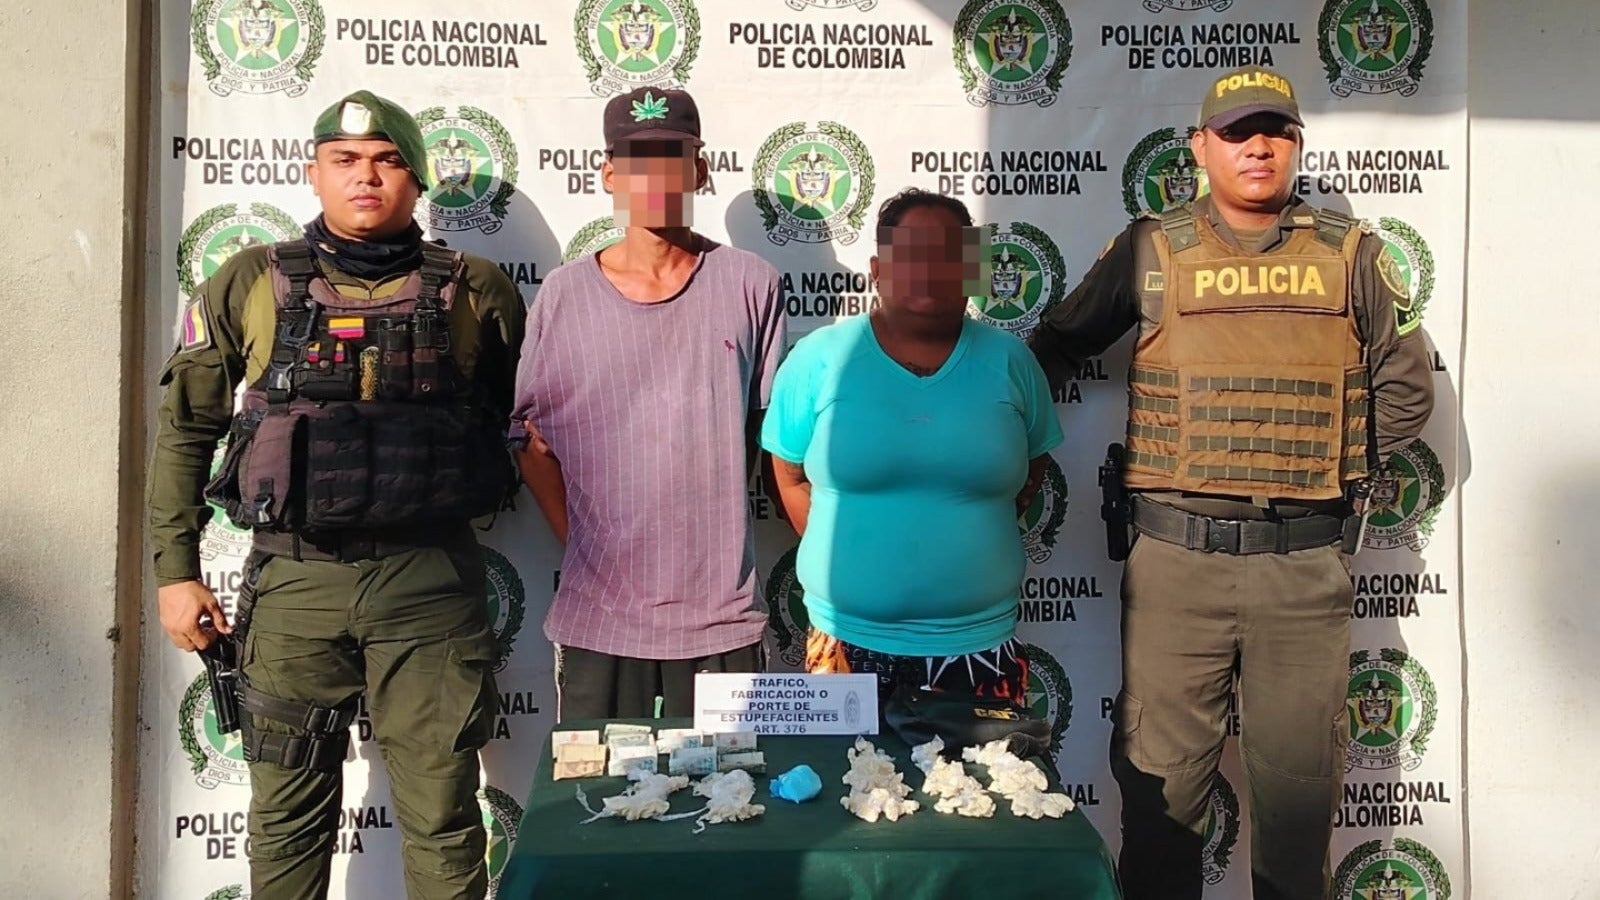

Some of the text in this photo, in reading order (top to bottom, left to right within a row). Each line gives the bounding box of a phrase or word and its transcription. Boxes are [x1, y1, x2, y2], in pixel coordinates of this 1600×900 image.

[967, 0, 999, 40] REPUBLICA
[1026, 0, 1057, 40] COLOMBIA
[336, 18, 548, 46] POLICIA NACIONAL
[729, 22, 933, 46] POLICIA NACIONAL
[1101, 22, 1300, 47] POLICIA NACIONAL
[217, 52, 303, 79] POLICIA NACIONAL
[365, 43, 519, 69] DE COLOMBIA
[598, 54, 679, 81] POLICIA NACIONAL
[758, 46, 906, 70] DE COLOMBIA
[1128, 46, 1274, 70] DE COLOMBIA
[1336, 54, 1414, 80] POLICIA NACIONAL
[221, 76, 297, 91] DIOS Y PATRIA
[601, 78, 623, 91] DIOS
[974, 63, 1053, 90] POLICIA NACIONAL
[1341, 78, 1409, 92] DIOS Y PATRIA
[978, 88, 1047, 103] DIOS Y PATRIA
[173, 136, 265, 160] POLICIA
[446, 119, 502, 164] DE COLOMBIA
[539, 148, 603, 171] POLIC
[767, 139, 799, 178] REPUBLICA
[806, 134, 819, 142] DE
[827, 138, 859, 177] COLOMBIA
[911, 150, 1107, 173] POLICIA NACIONAL
[1136, 139, 1188, 184] REPUBLICA DE
[1347, 149, 1450, 171] NACIONAL
[203, 162, 310, 185] DE COLO
[568, 173, 596, 195] DE
[938, 174, 1081, 196] DE COLOMBIA
[1318, 172, 1423, 195] COLOMBIA
[456, 189, 497, 217] NACIONAL
[445, 221, 451, 229] Y
[458, 214, 492, 229] PATRIA
[774, 201, 854, 229] POLICIA NACIONAL
[193, 220, 230, 263] REPUBLICA
[237, 215, 252, 224] DE
[778, 226, 849, 241] DIOS Y PATRIA
[998, 233, 1051, 277] DE COLOMBIA
[1387, 234, 1419, 272] COLOMBIA
[1195, 265, 1326, 298] POLICIA
[786, 295, 882, 317] OLOMBIA
[1007, 302, 1046, 329] NACIONAL
[207, 521, 236, 541] OLICIA
[1386, 508, 1424, 535] NACIONAL
[206, 540, 242, 555] DIOS Y
[1377, 539, 1383, 547] Y
[1388, 532, 1418, 546] PATRIA
[1020, 577, 1103, 599] CIONAL
[1351, 596, 1420, 619] OMBIA
[1368, 661, 1381, 669] DE
[751, 678, 809, 689] TRAFICO,
[1030, 662, 1056, 699] OLOMBIA
[731, 690, 828, 699] FABRICACION O
[749, 701, 811, 711] PORTE DE
[721, 712, 839, 722] ESTUPEFACIENTES
[753, 724, 806, 734] ART. 376
[1379, 728, 1416, 754] NACIONAL
[204, 746, 238, 769] POLICIA
[1369, 759, 1375, 767] Y
[1381, 752, 1411, 766] PATRIA
[208, 769, 245, 783] DIOS Y
[1343, 781, 1450, 804] NACIONAL
[206, 836, 237, 860] DE
[1344, 851, 1435, 897] REPUBLICA DE COLOMBIA
